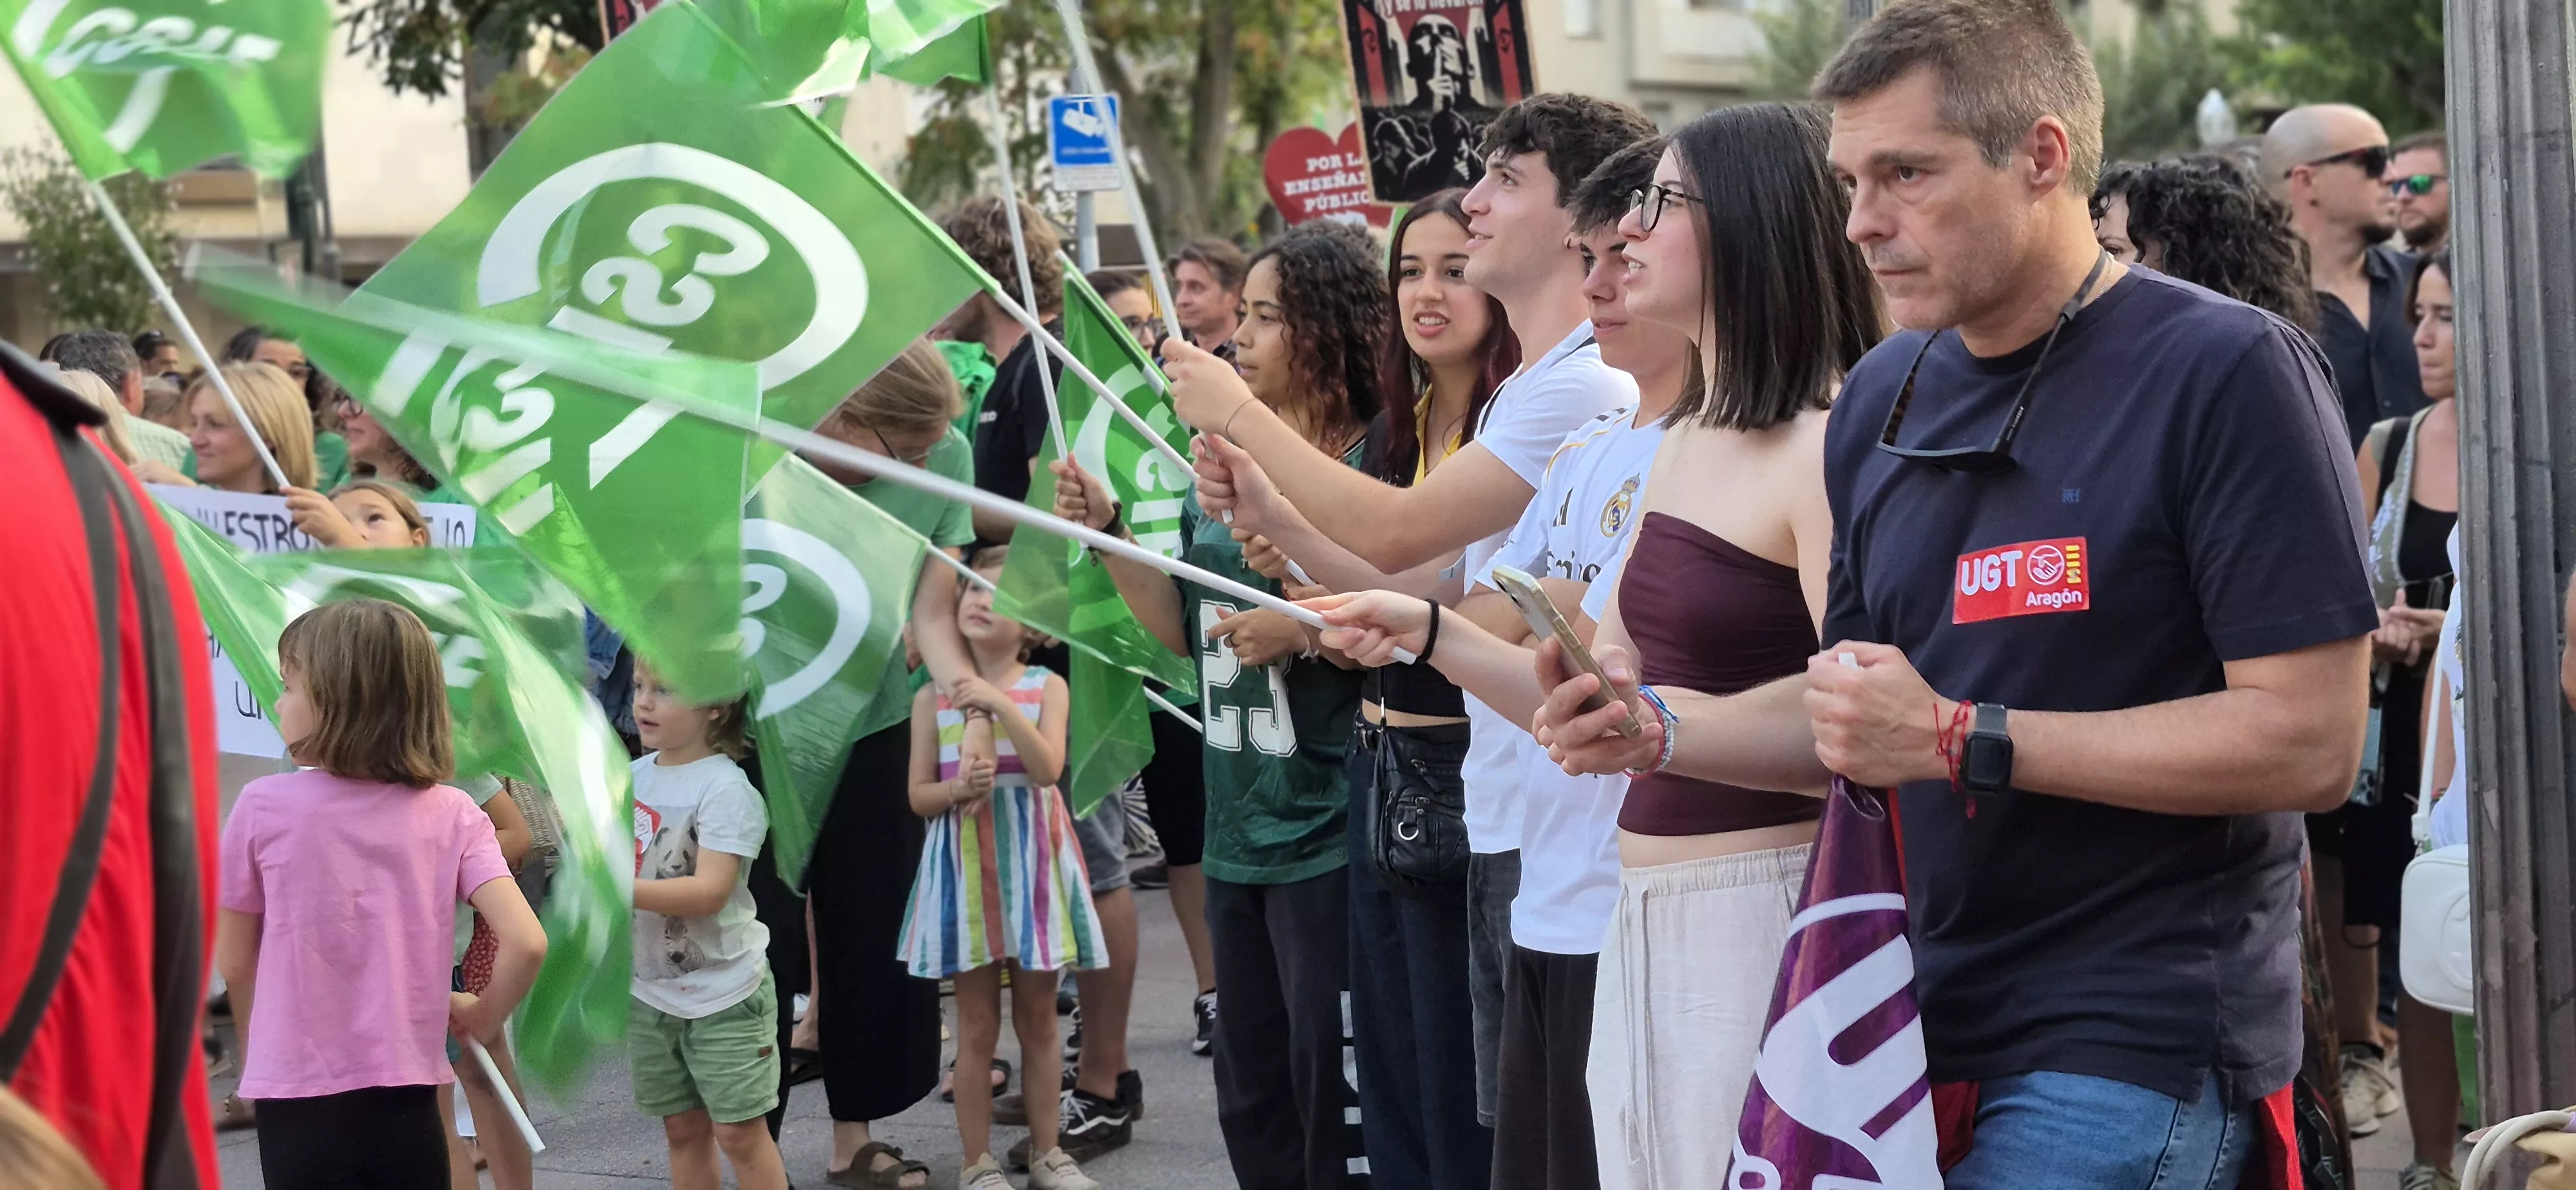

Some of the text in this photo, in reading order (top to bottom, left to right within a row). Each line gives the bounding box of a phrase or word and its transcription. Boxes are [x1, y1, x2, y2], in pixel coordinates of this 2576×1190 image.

[1306, 153, 1364, 173] POR L
[1304, 191, 1370, 213] PÚBLIC
[1961, 550, 2023, 596] UGT
[2025, 587, 2082, 609] Aragón
